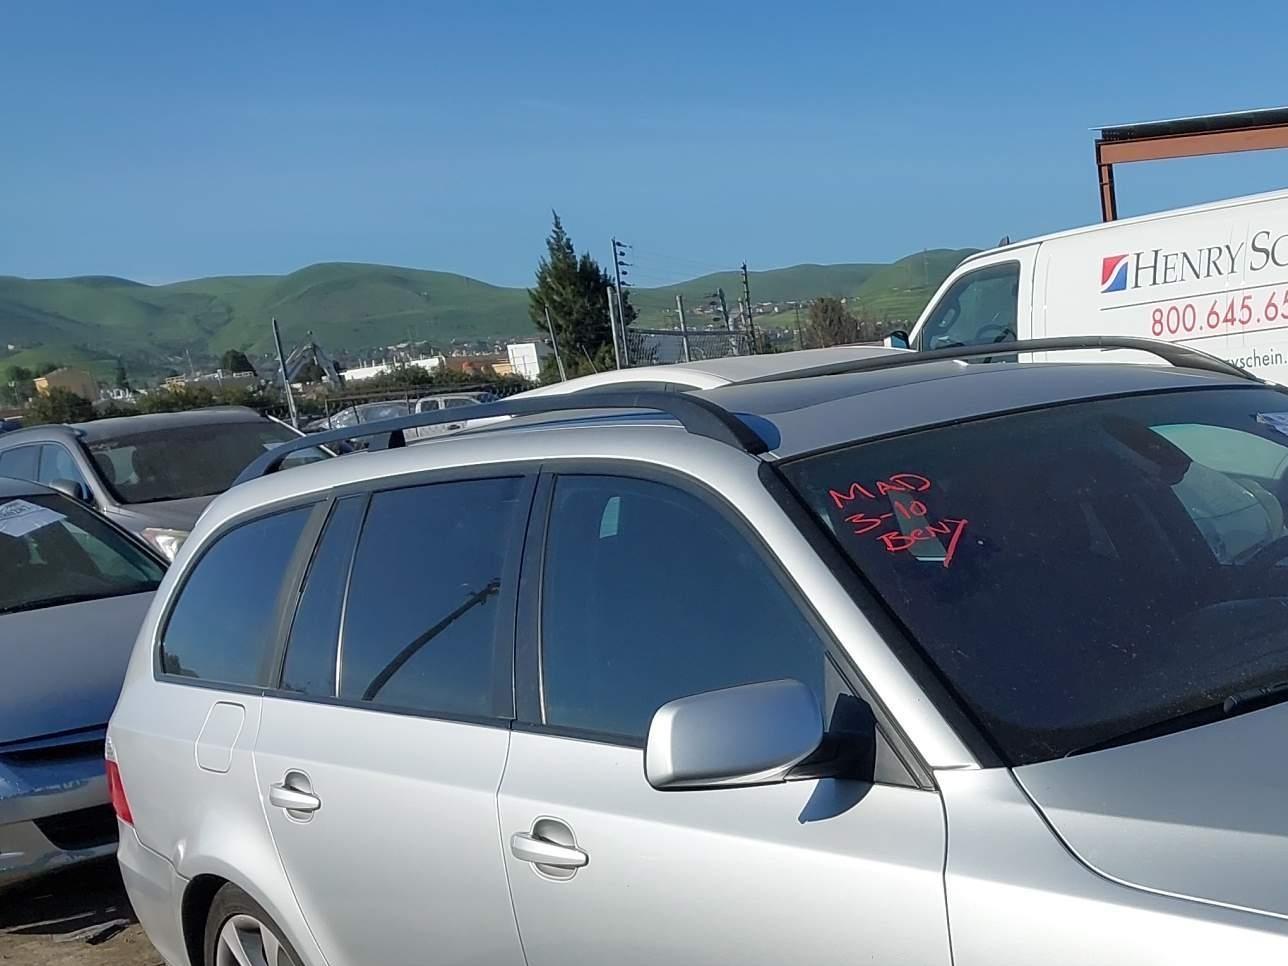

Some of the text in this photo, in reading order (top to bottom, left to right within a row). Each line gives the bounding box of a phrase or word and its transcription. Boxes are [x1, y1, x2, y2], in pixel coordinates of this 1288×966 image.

[1132, 242, 1244, 289] HENRY
[829, 473, 931, 509] MAD
[844, 501, 927, 534] 3-10
